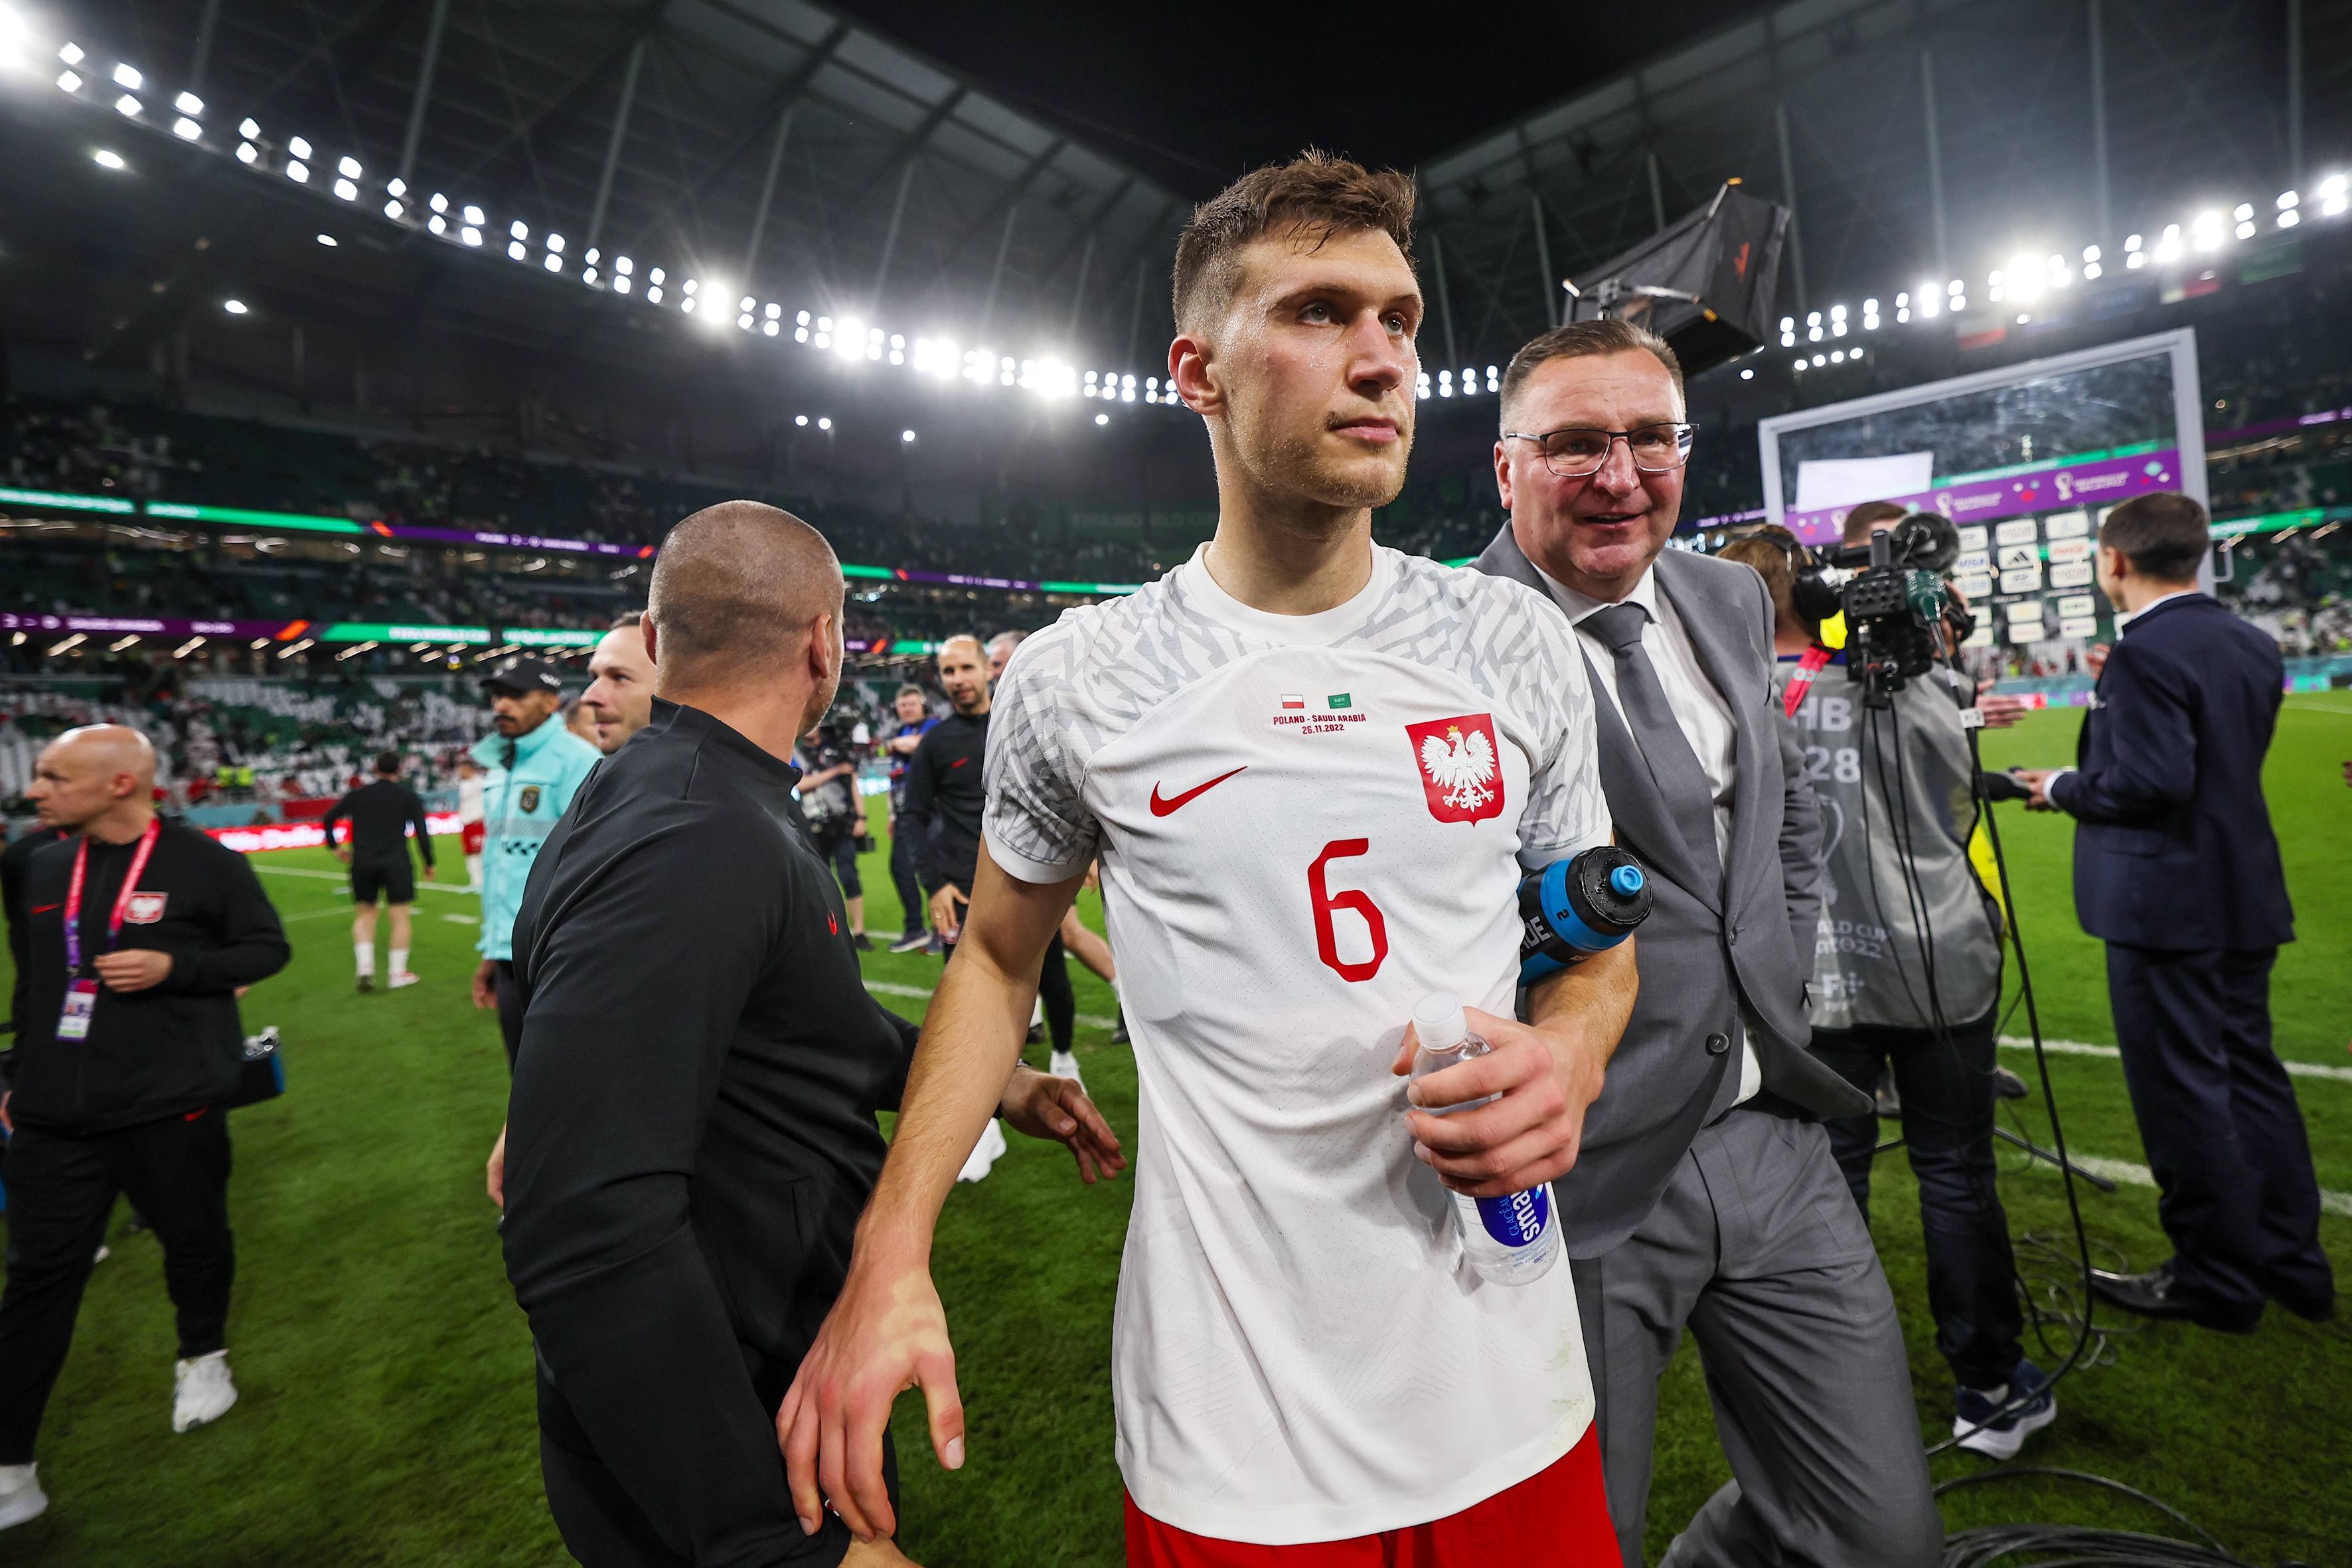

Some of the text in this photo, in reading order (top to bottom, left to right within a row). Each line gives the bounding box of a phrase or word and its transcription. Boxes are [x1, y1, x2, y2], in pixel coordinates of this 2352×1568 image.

[1273, 716, 1304, 725] POLAND
[1338, 714, 1366, 722] ARABIA
[1302, 724, 1345, 734] 26.11.2022
[1307, 838, 1389, 982] 6
[1556, 909, 1570, 921] 2
